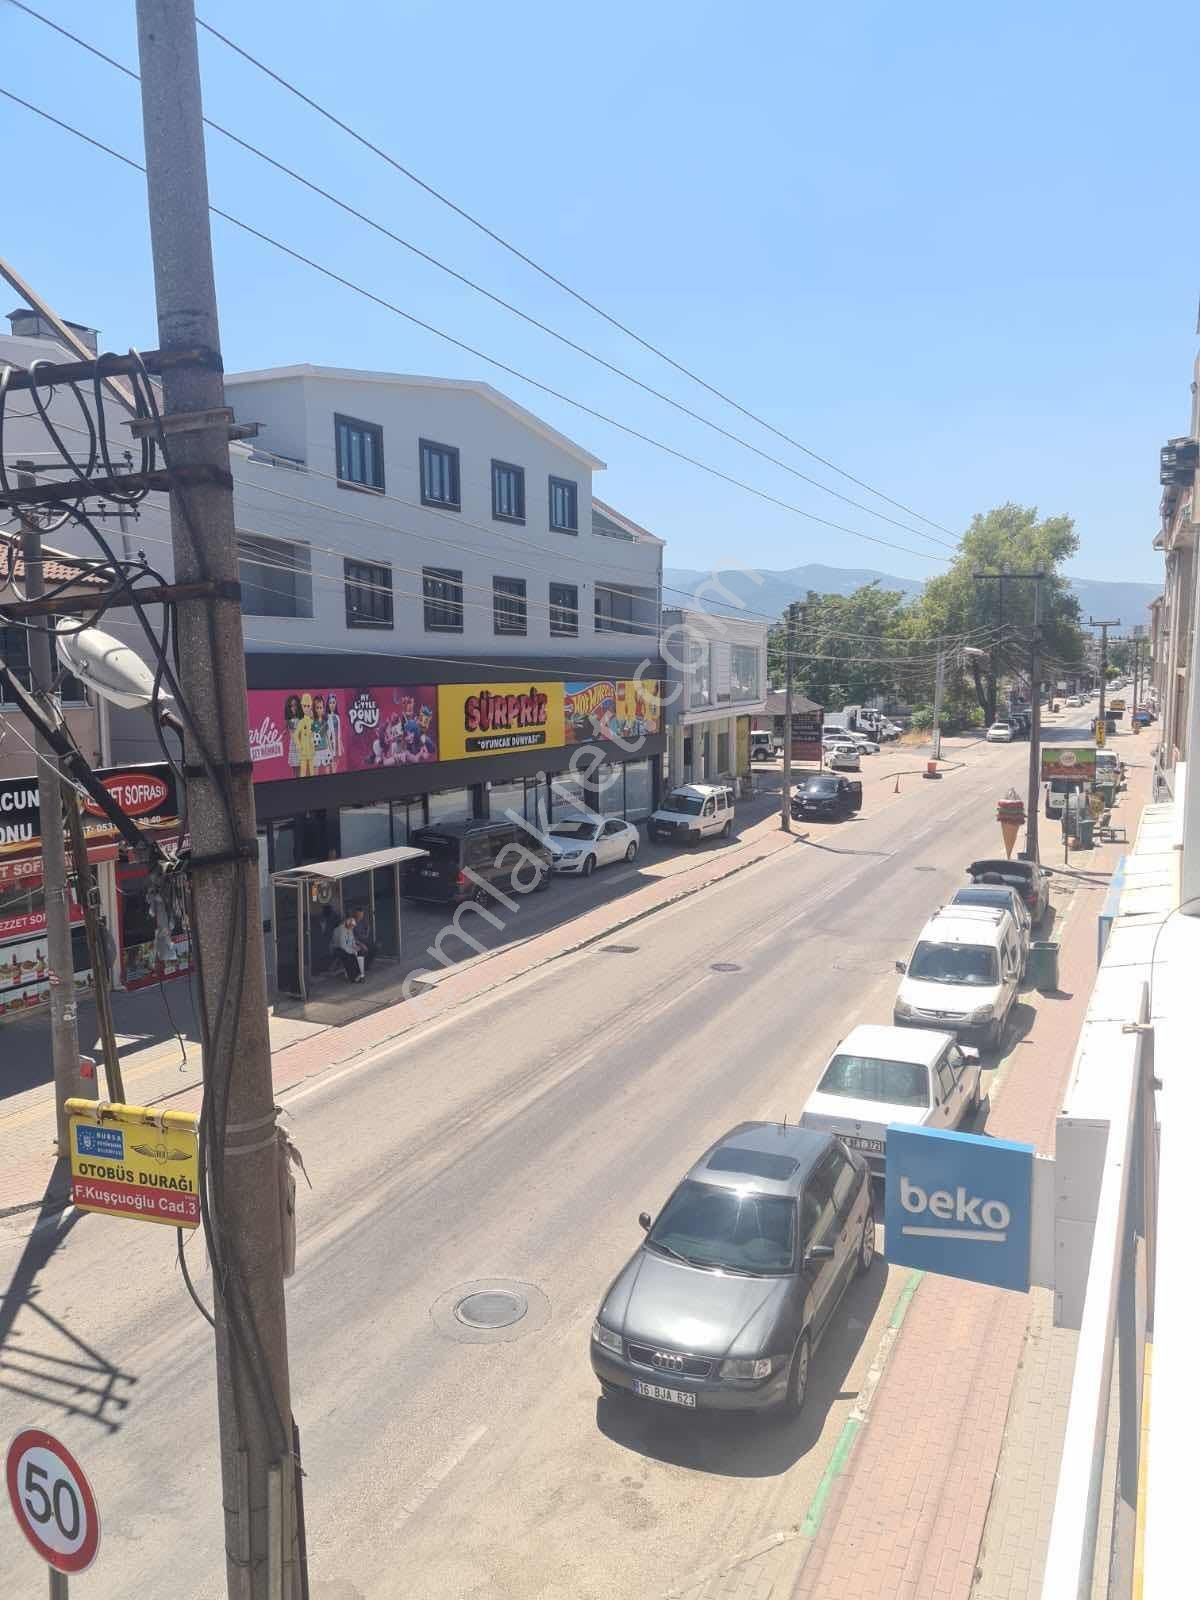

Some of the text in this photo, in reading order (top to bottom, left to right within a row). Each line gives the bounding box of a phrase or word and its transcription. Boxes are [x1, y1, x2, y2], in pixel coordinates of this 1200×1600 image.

[465, 686, 547, 732] SÜRPRİZ
[0, 789, 40, 812] CUN
[13, 859, 44, 877] SOF
[79, 1162, 193, 1192] OTOBÜS DURAĞI
[75, 1184, 197, 1216] F.Kuşçuoğlu Cad.3
[900, 1175, 1011, 1230] beko
[25, 1461, 80, 1540] 50
